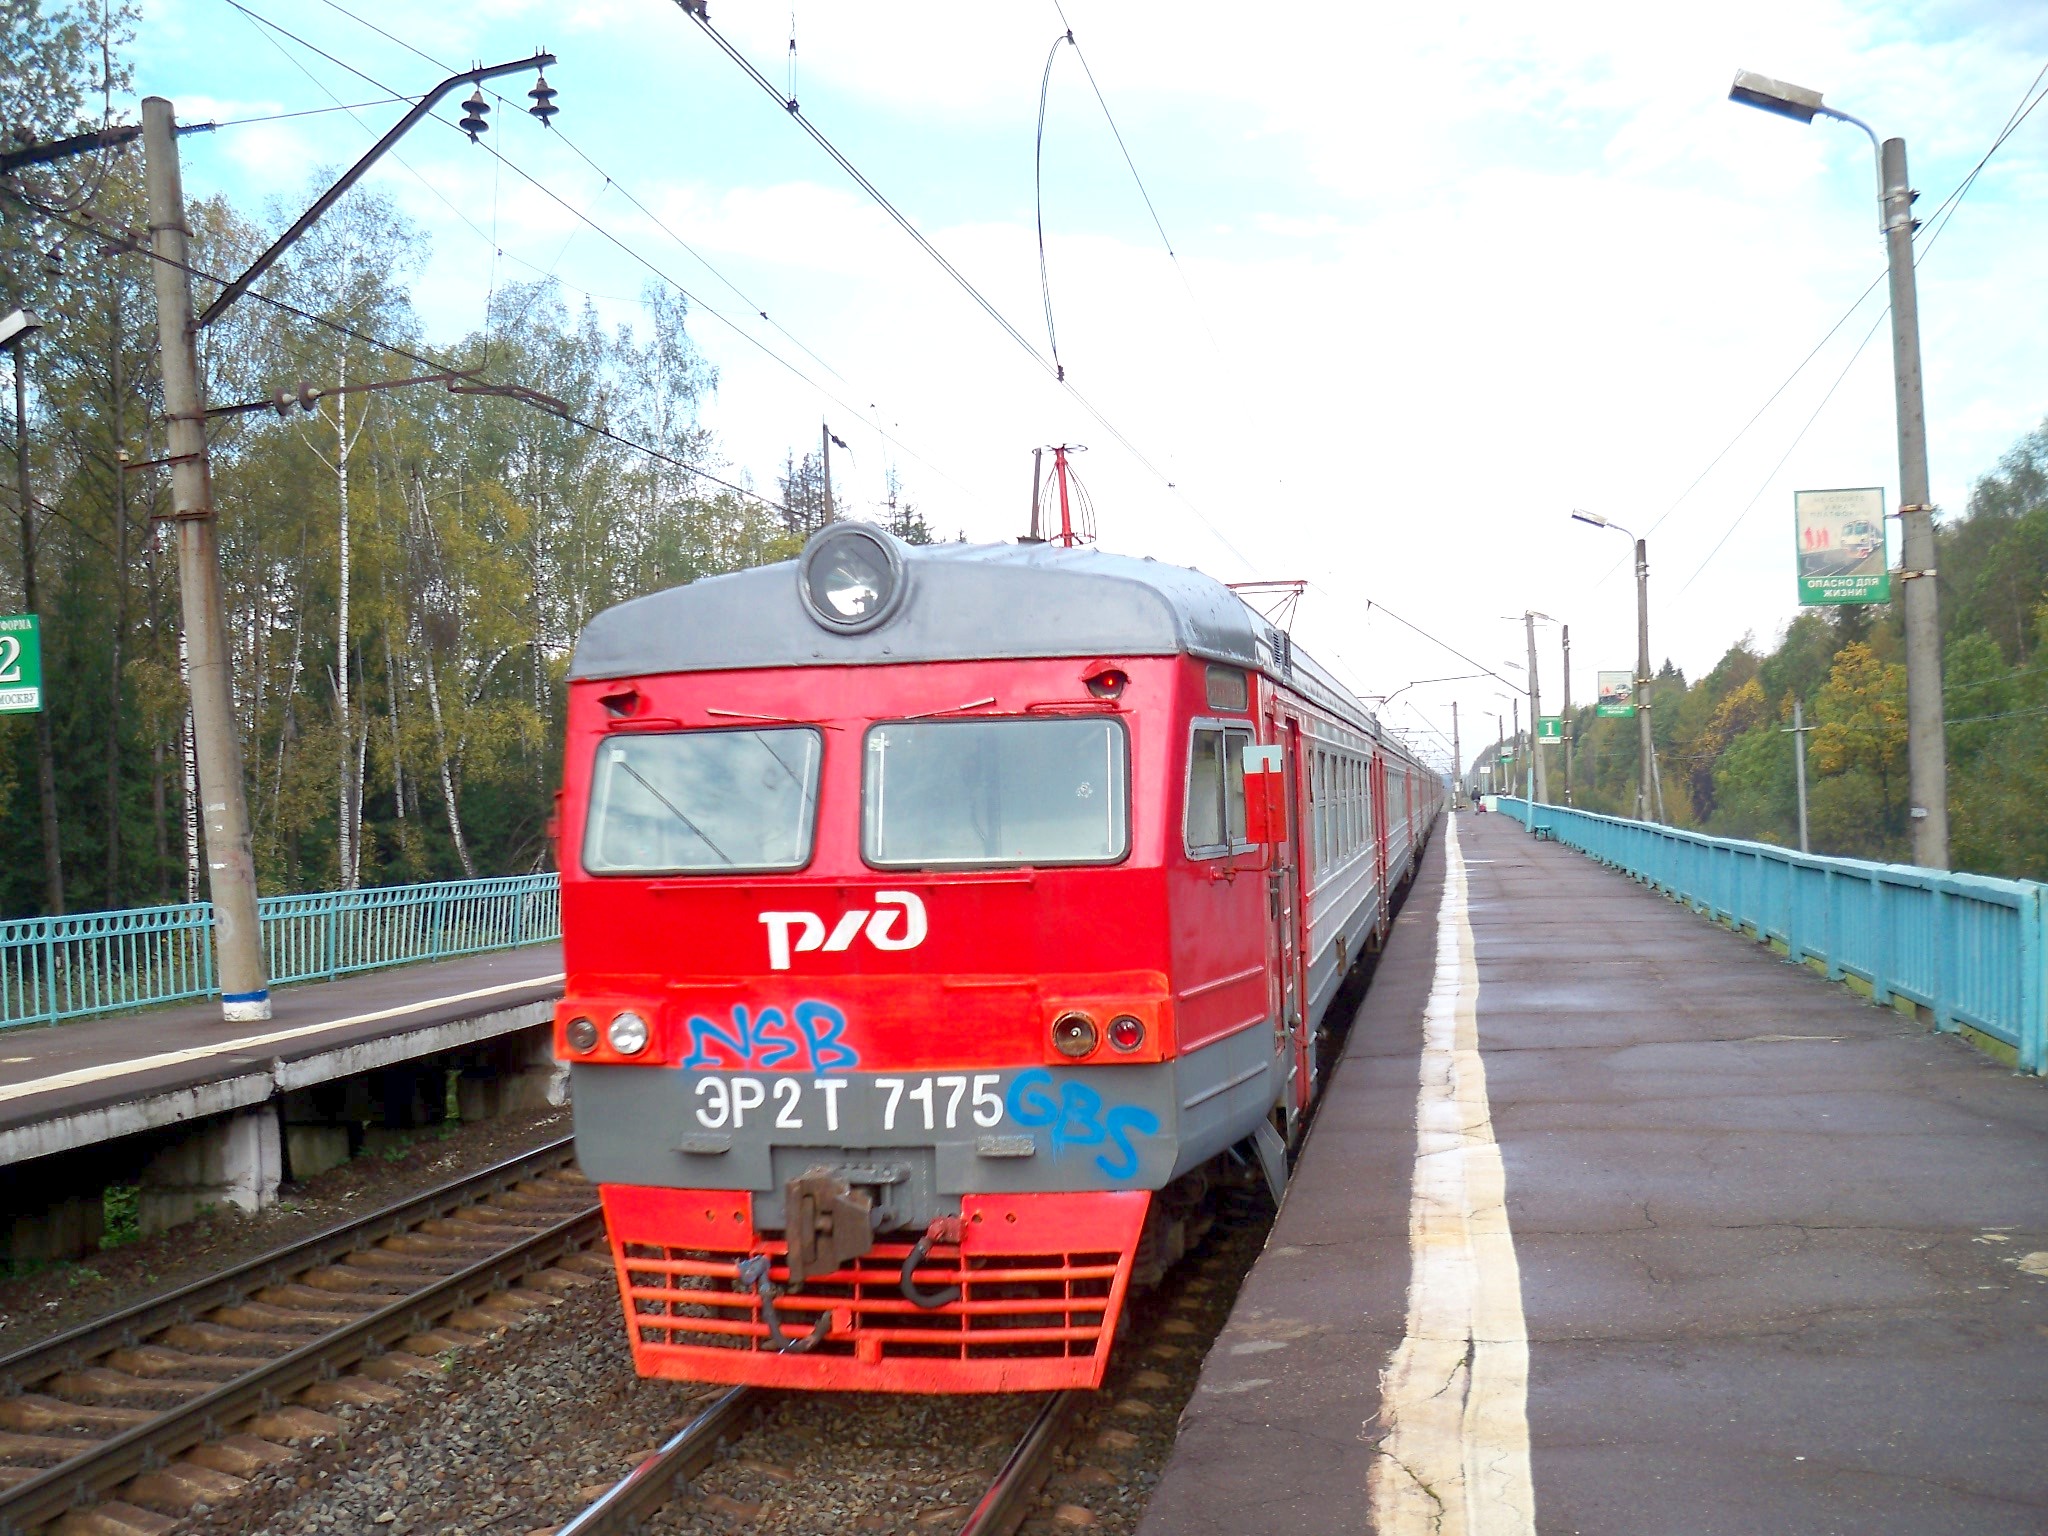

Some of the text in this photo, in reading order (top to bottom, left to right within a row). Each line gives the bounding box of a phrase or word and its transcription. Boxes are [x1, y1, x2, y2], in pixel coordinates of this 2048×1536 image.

[1807, 577, 1879, 588] ОПАСНО ДЛЯ
[1823, 588, 1867, 597] ЖИЗНИ!
[0, 619, 32, 631] ФОРМА
[0, 636, 21, 682] 2
[1545, 721, 1556, 736] 1
[681, 999, 860, 1077] NSB
[875, 1074, 1004, 1131] 7175
[1006, 1068, 1160, 1180] GBS
